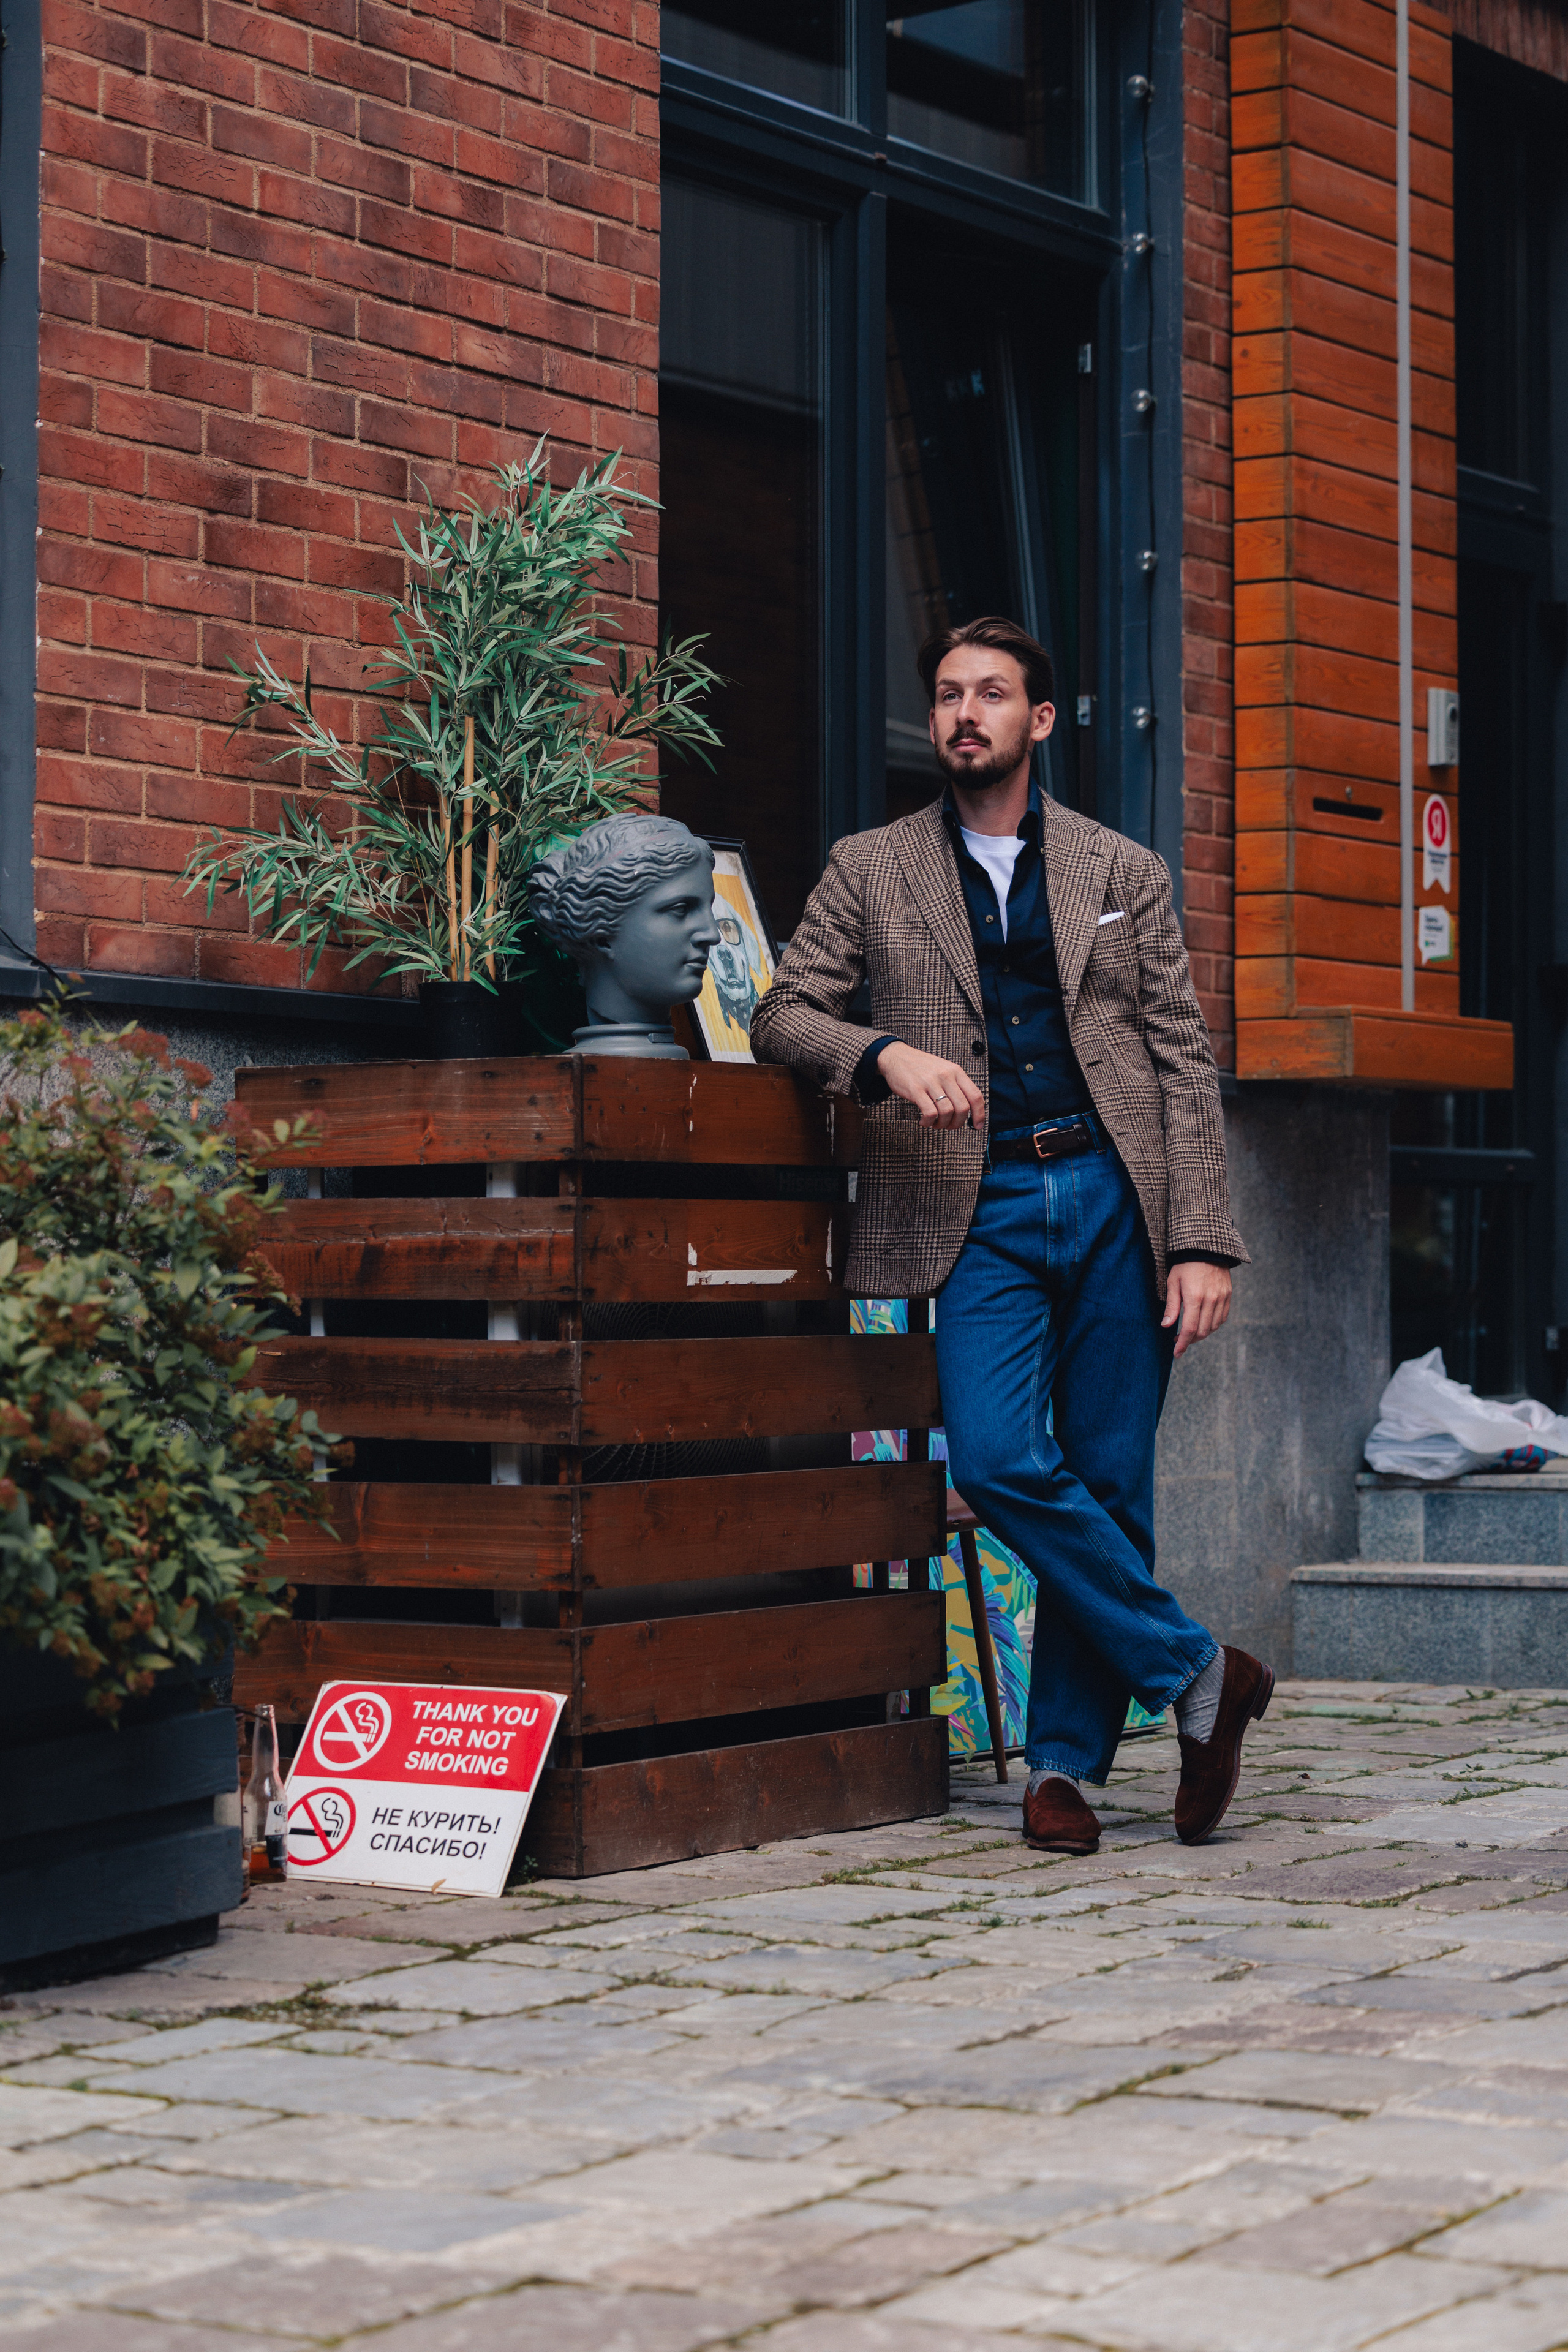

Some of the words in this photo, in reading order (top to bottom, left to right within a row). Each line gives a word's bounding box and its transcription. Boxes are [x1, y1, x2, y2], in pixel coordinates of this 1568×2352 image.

[412, 1700, 488, 1723] THANK
[492, 1705, 540, 1727] YOU
[415, 1726, 464, 1747] FOR
[466, 1729, 516, 1751] NOT
[404, 1751, 509, 1776] SMOKING
[371, 1807, 404, 1826] НЕ
[407, 1809, 502, 1834] КУРИТЬ!
[369, 1833, 487, 1860] СПАСИБО!
